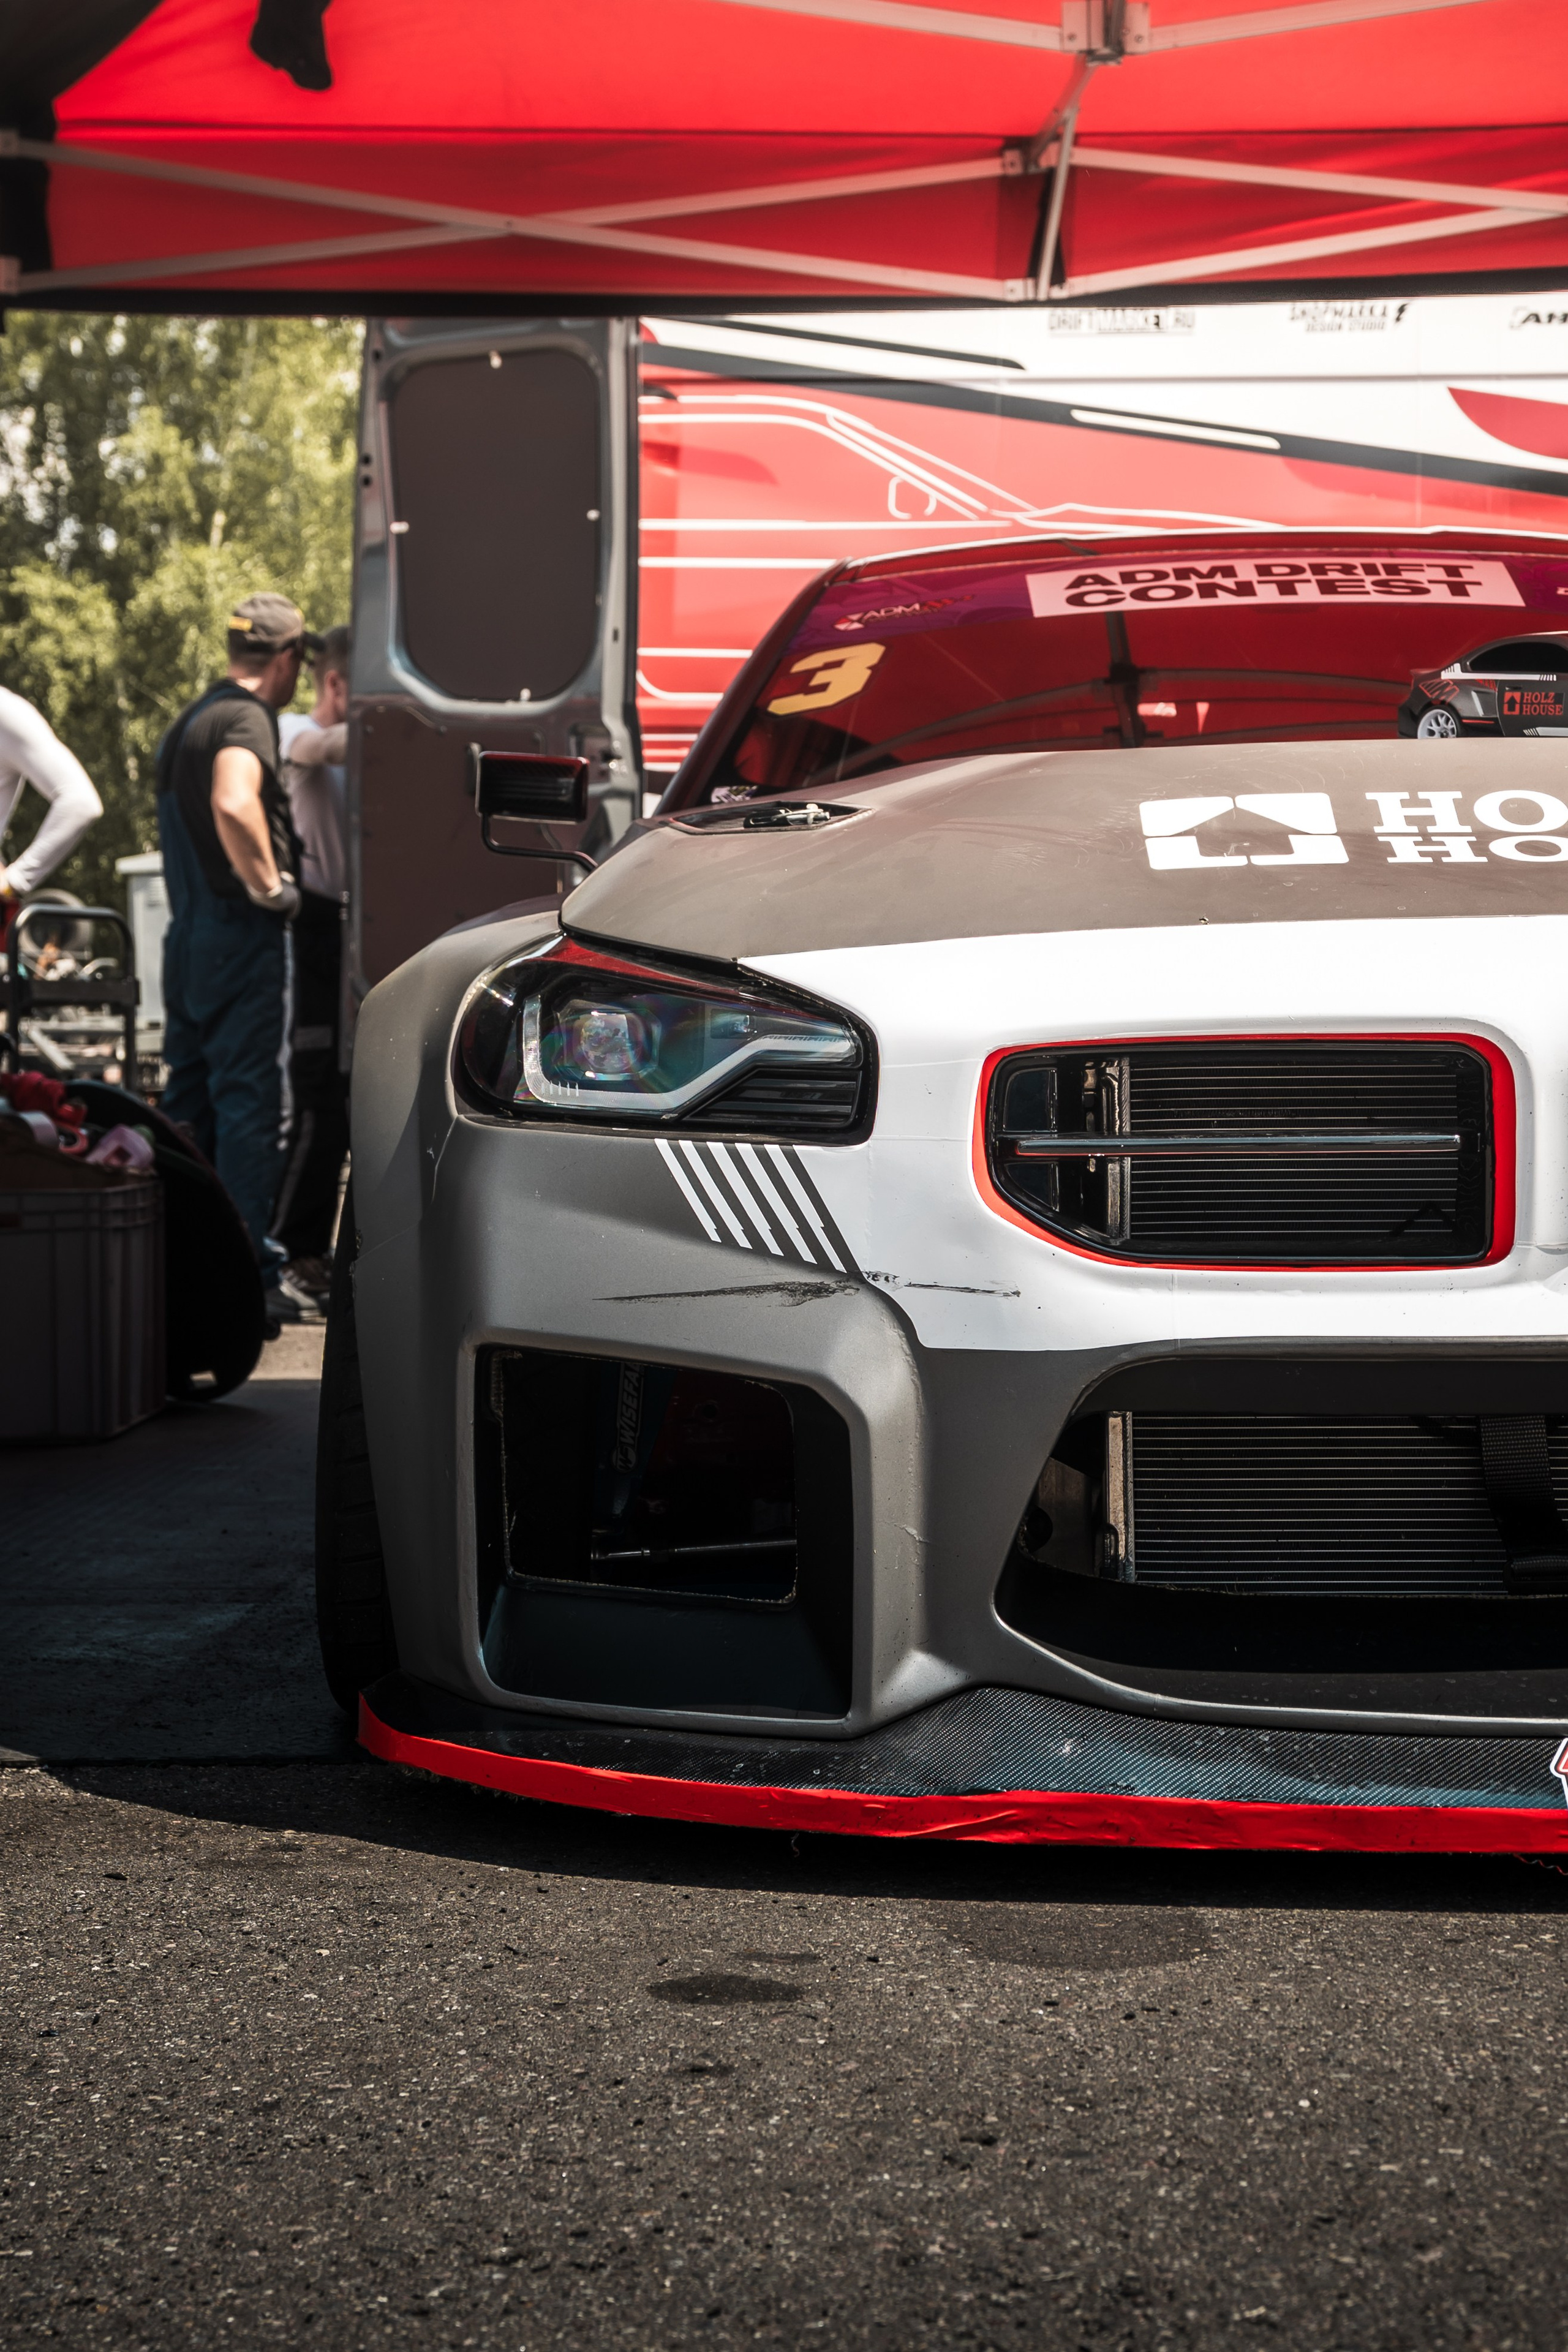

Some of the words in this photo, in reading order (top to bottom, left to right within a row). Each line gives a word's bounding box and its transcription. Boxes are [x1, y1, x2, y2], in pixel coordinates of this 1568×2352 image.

[1065, 565, 1238, 590] ADM
[1254, 562, 1474, 578] DRIFT
[1065, 578, 1482, 607] CONTEST
[767, 642, 886, 716] 3
[1522, 704, 1563, 715] HOUSE
[1523, 692, 1555, 703] HOLZ
[1365, 790, 1568, 833] HO
[1378, 835, 1568, 862] HO
